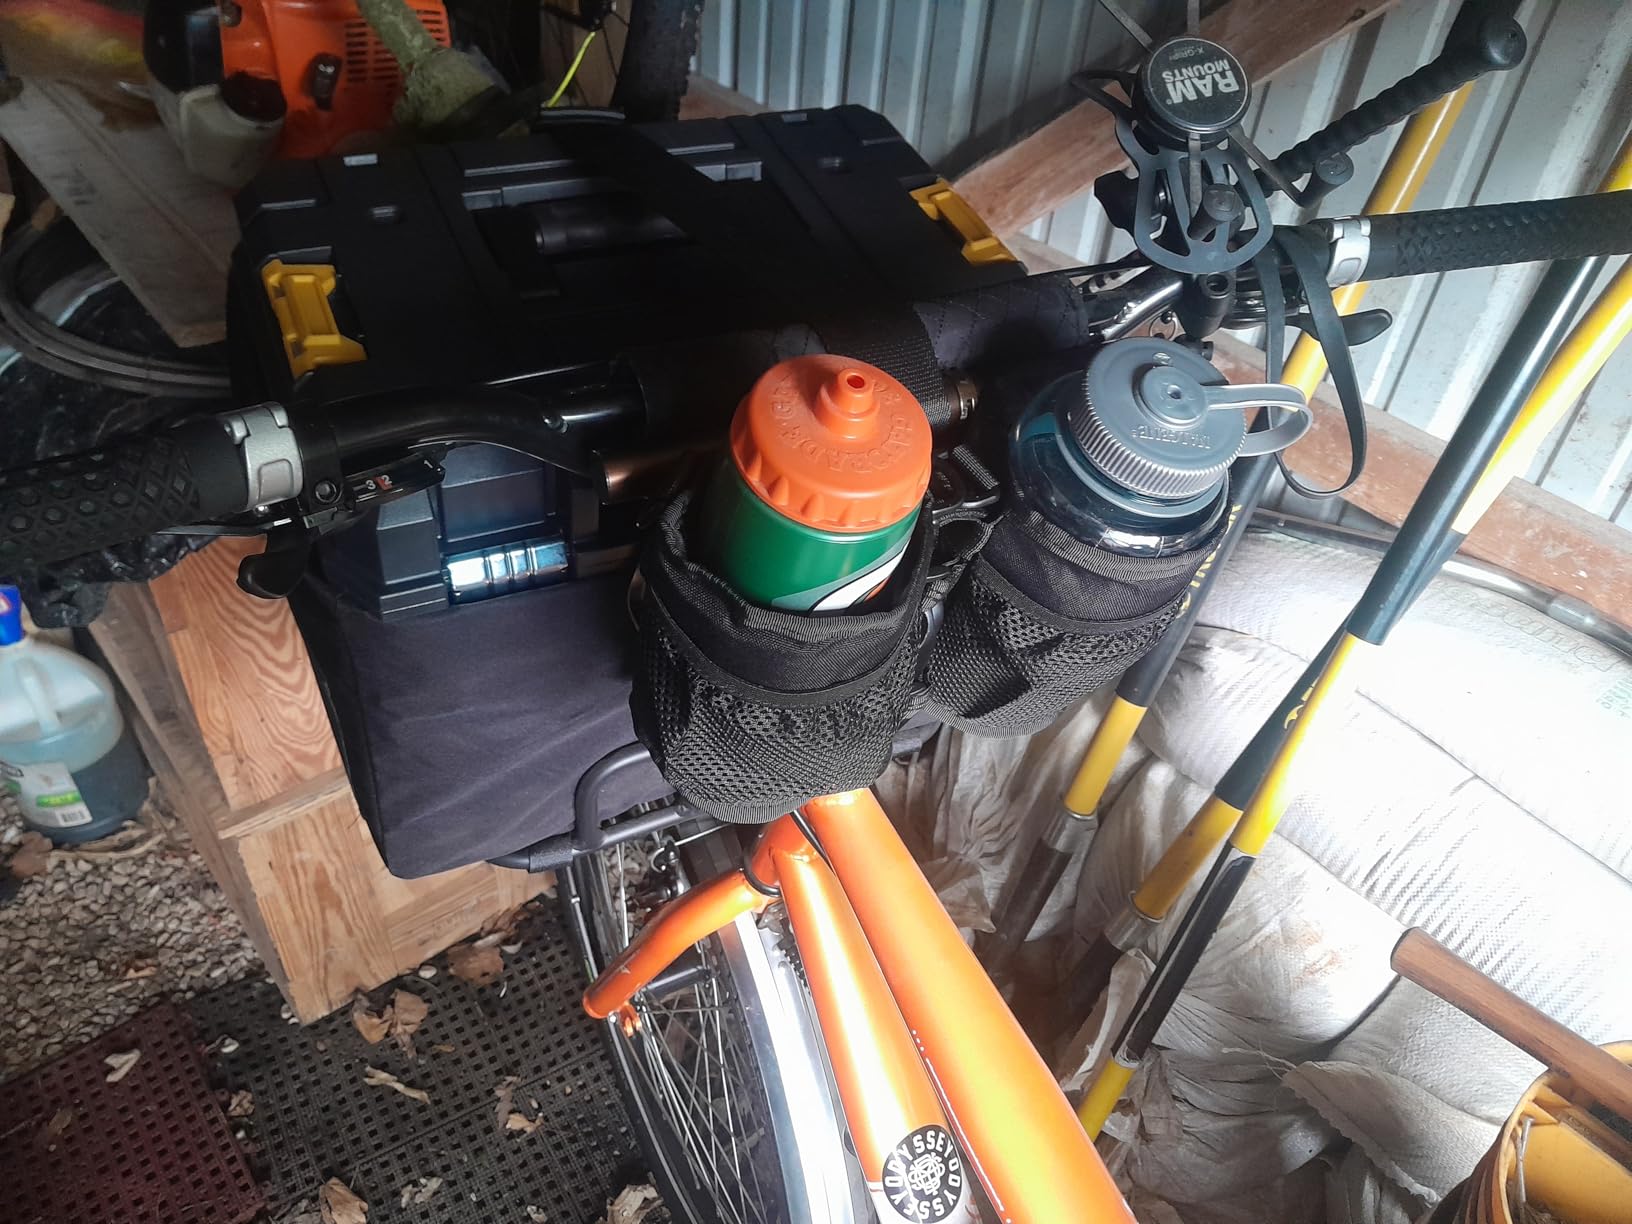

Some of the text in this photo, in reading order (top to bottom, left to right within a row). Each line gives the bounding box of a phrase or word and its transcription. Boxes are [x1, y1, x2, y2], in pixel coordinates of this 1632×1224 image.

[1162, 59, 1231, 83] MOUNTS
[1165, 70, 1240, 104] RAM
[365, 459, 434, 490] 3 2 1
[884, 1130, 954, 1188] ODYSSEY
[889, 1157, 962, 1220] ODYSSEY
